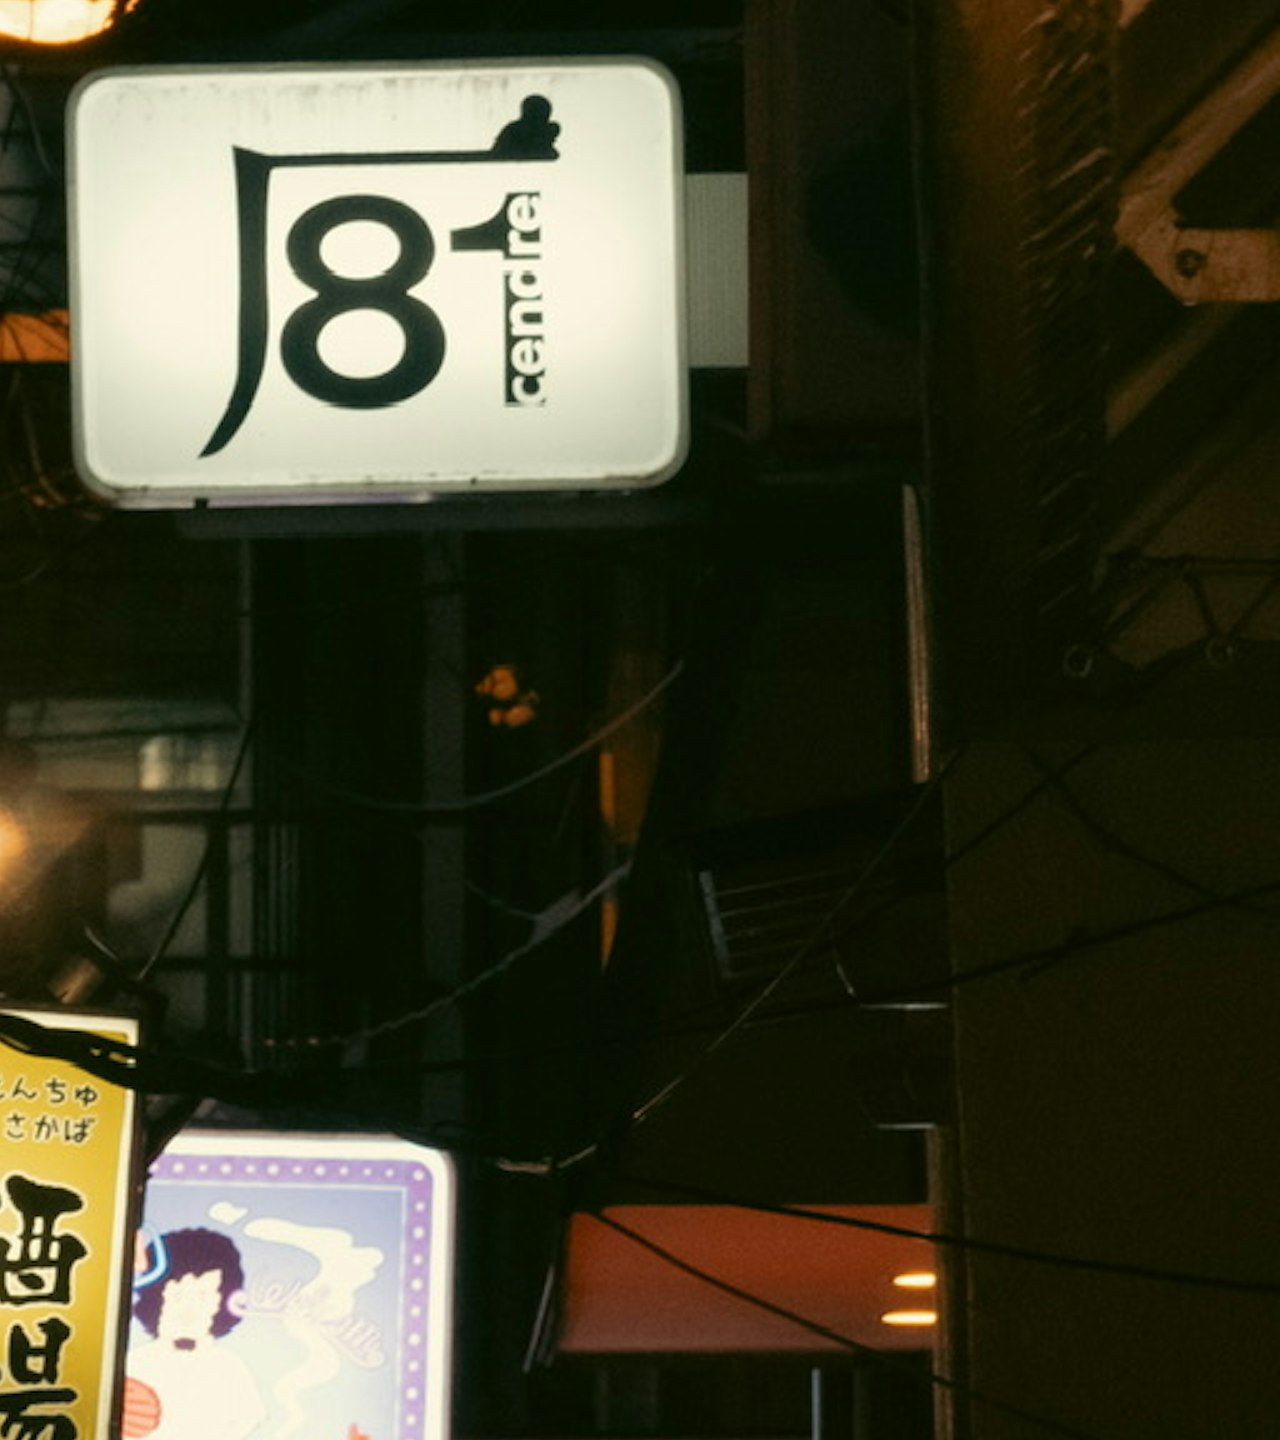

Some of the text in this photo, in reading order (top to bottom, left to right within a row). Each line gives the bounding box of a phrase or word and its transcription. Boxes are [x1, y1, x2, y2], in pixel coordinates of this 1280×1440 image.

[506, 190, 546, 408] cendre
[4, 1112, 95, 1145] さかば
